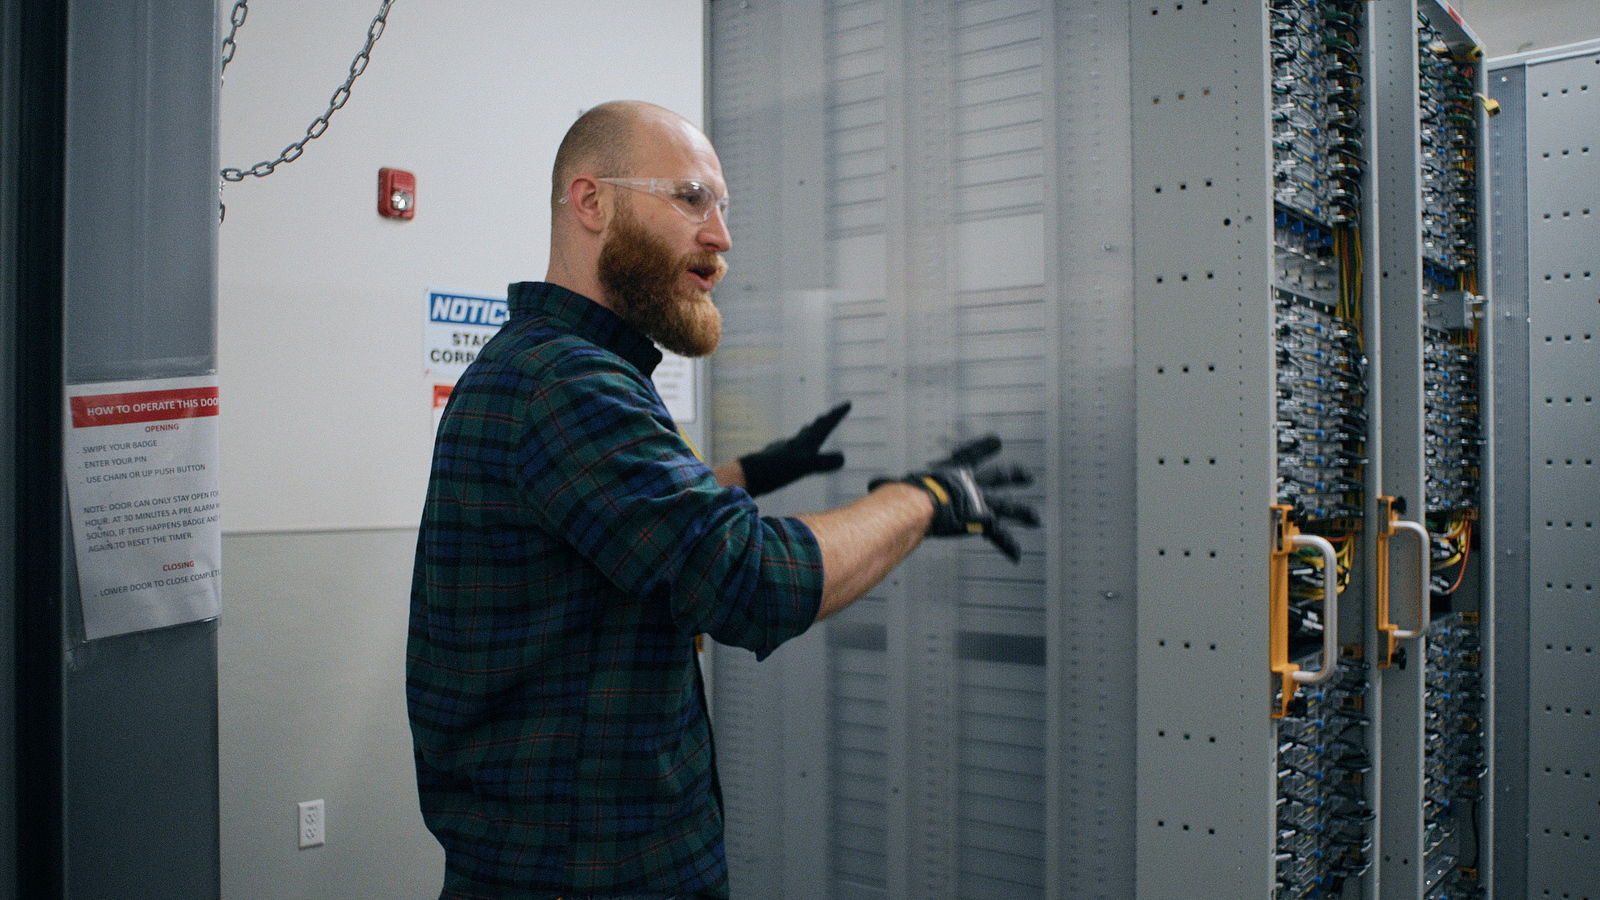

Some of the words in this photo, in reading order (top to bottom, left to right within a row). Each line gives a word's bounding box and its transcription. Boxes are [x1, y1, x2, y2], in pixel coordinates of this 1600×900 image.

[431, 296, 510, 325] NOTIC
[87, 406, 114, 416] HOW
[116, 404, 130, 414] TO
[132, 400, 175, 412] OPERATE
[177, 398, 198, 409] THIS
[145, 423, 179, 433] OPENING
[82, 444, 107, 454] SWIPE
[109, 442, 131, 451] YOUR
[132, 440, 158, 448] BADGE
[84, 460, 110, 469] ENTER
[111, 457, 133, 466] YOUR
[134, 455, 147, 463] PIN
[86, 475, 101, 484] USE
[103, 473, 127, 482] CHAIN
[129, 471, 141, 479] OR
[154, 467, 175, 475] PUSH
[176, 464, 206, 473] BUTTON
[83, 504, 107, 514] NOTE:
[109, 501, 132, 511] DOOR
[134, 498, 150, 508] CAN
[152, 496, 171, 506] ONLY
[173, 494, 190, 503] STAY
[191, 492, 209, 500] OPEN
[112, 515, 122, 523] AT
[124, 514, 133, 522] 30
[135, 510, 170, 520] MINUTES
[171, 507, 177, 515] A
[179, 506, 192, 515] PRE
[193, 502, 215, 513] ALARM
[118, 528, 125, 536] IF
[127, 525, 144, 534] THIS
[146, 520, 181, 532] HAPPENS
[182, 516, 205, 527] BADGE
[206, 514, 218, 523] AND
[88, 542, 113, 553] AGAIN
[115, 541, 126, 549] TO
[127, 538, 150, 548] RESET
[152, 535, 166, 544] THE
[162, 560, 195, 572] CLOSING
[100, 585, 128, 597] LOWER
[130, 582, 152, 592] DOOR
[154, 579, 165, 588] TO
[166, 576, 189, 586] CLOSE
